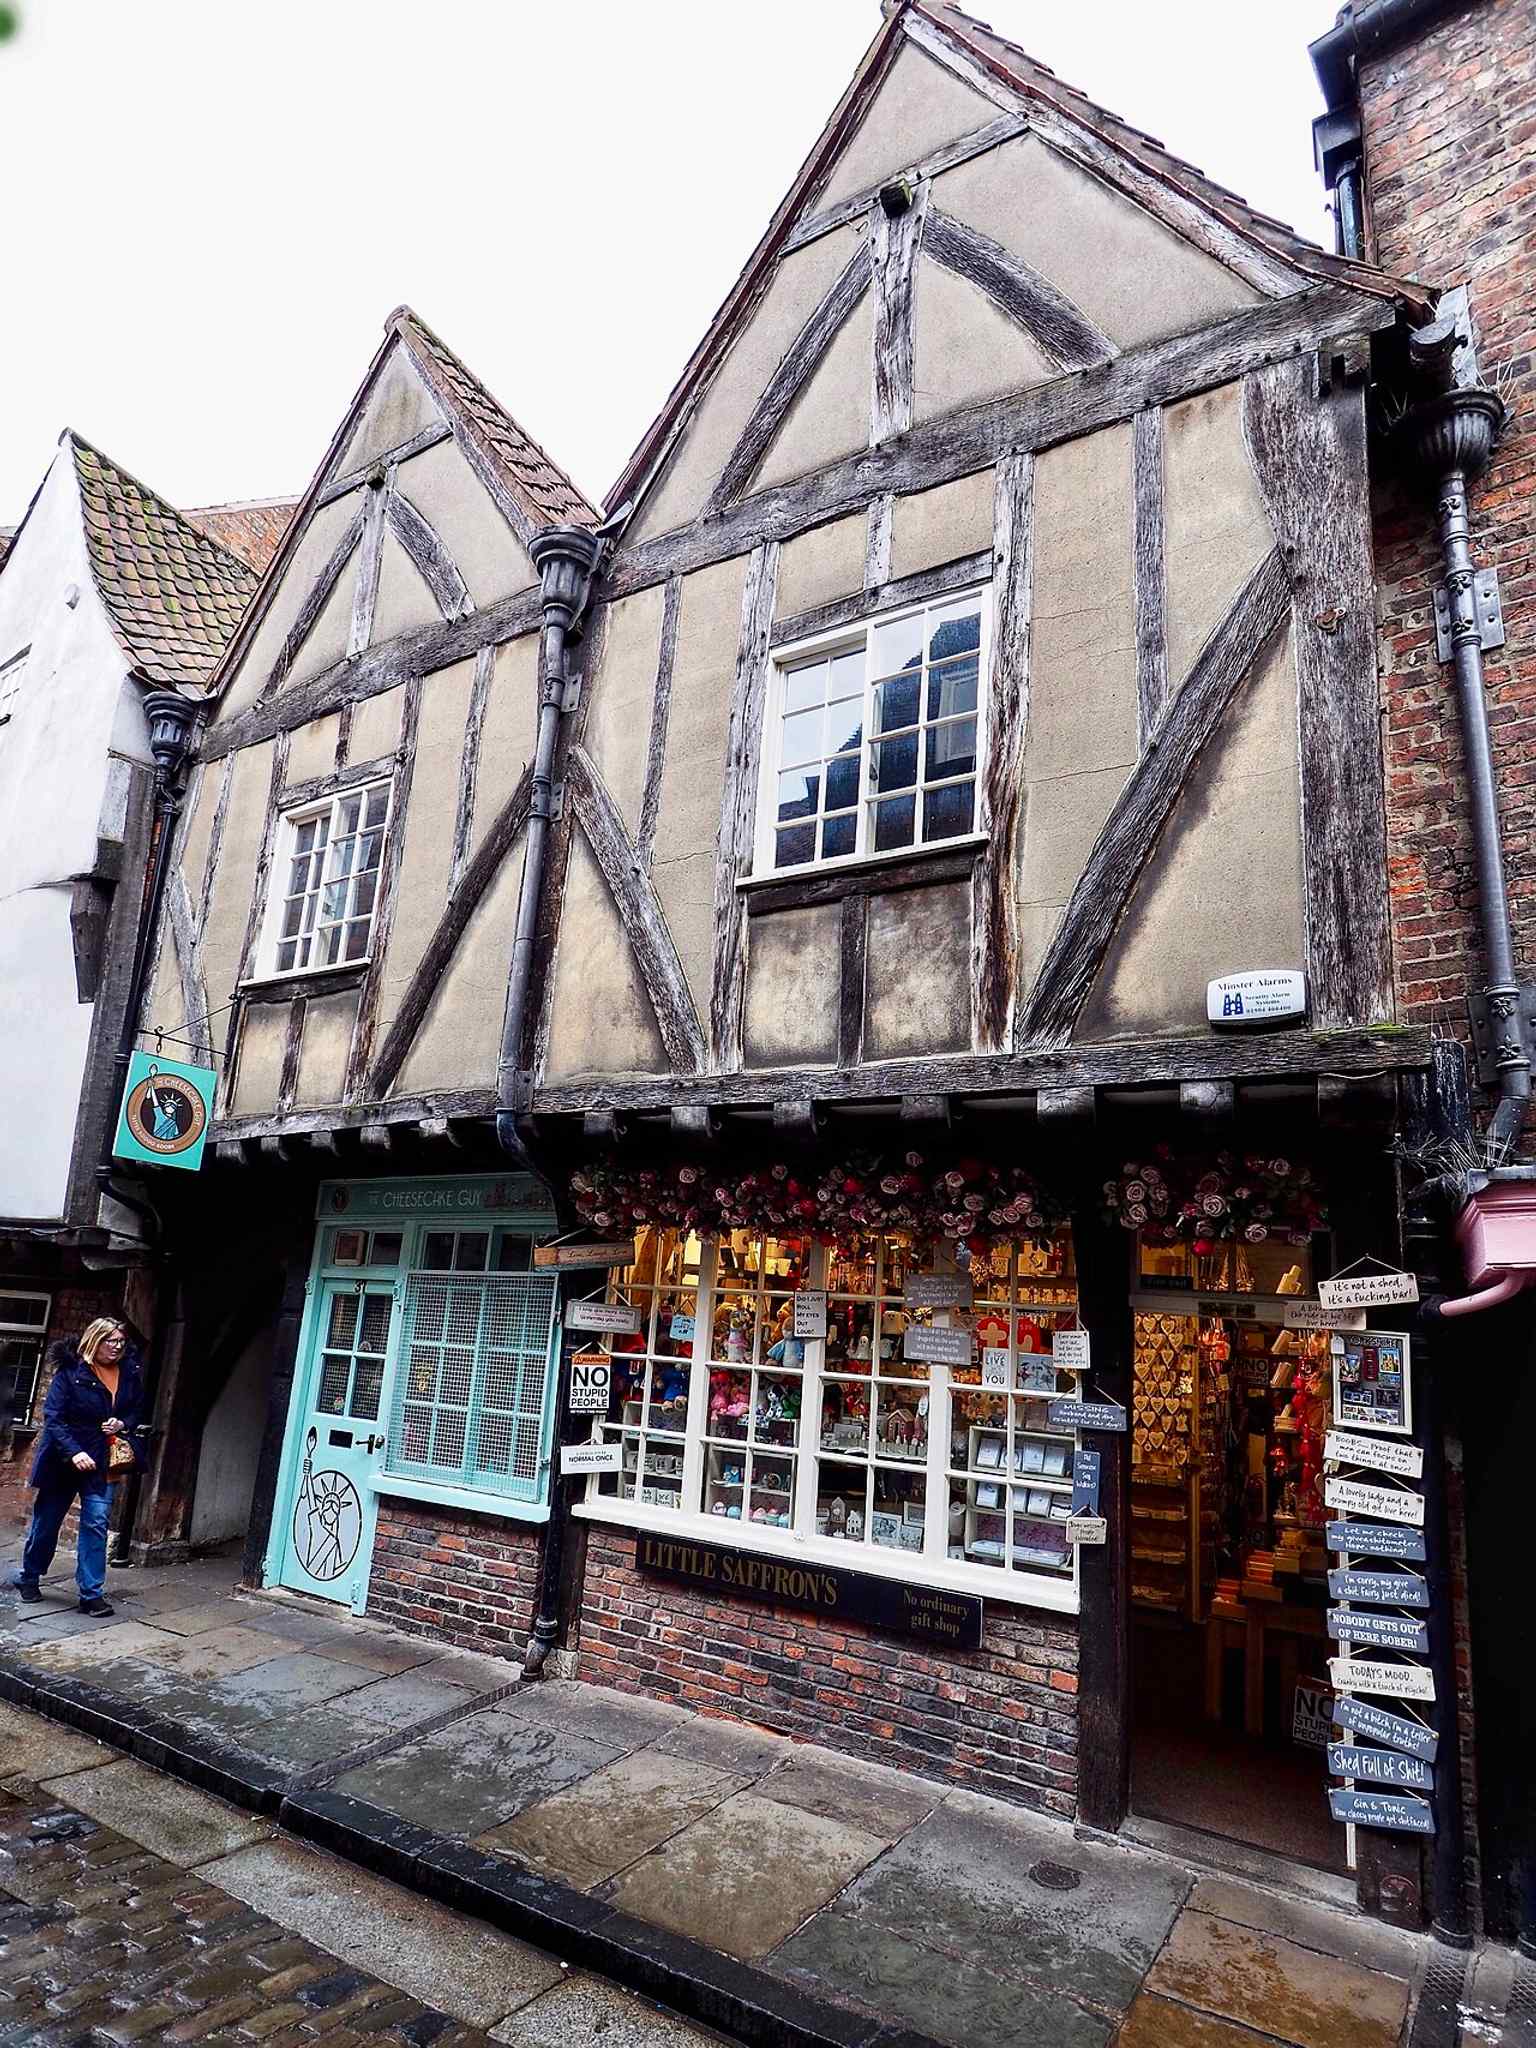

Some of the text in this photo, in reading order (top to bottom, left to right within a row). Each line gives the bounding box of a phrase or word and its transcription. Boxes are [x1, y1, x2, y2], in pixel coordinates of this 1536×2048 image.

[1218, 978, 1292, 990] Minster Alarms
[383, 1190, 453, 1208] CHEESECAKE
[457, 1188, 481, 1206] GUY
[1334, 1281, 1349, 1291] It's
[1352, 1280, 1366, 1290] not
[1328, 1294, 1343, 1305] It's
[1355, 1290, 1390, 1302] fucking
[1392, 1288, 1412, 1299] bar!
[573, 1367, 609, 1387] NO
[986, 1375, 1005, 1385] YOU
[572, 1389, 608, 1397] STUPID
[571, 1398, 607, 1407] PEOPLE
[569, 1455, 594, 1463] NORMAL
[1373, 1450, 1395, 1460] focus
[1339, 1485, 1344, 1495] A
[1346, 1487, 1366, 1500] lovely
[1367, 1490, 1385, 1504] lady
[1387, 1496, 1402, 1506] and
[1330, 1496, 1356, 1509] grumpy
[1358, 1500, 1370, 1511] old
[1384, 1505, 1397, 1514] live
[1399, 1508, 1418, 1518] here!
[1344, 1527, 1360, 1535] Let
[1377, 1530, 1404, 1538] check
[1370, 1545, 1407, 1555] nothing!
[644, 1539, 838, 1606] LITTLE SAFFRON'S
[1344, 1574, 1355, 1584] I'm
[1380, 1580, 1392, 1589] my
[1393, 1579, 1408, 1590] give
[1344, 1586, 1359, 1596] shit
[1381, 1589, 1398, 1600] just
[1401, 1591, 1421, 1602] died!
[904, 1588, 968, 1617] No ordinary
[911, 1611, 960, 1638] gift shop
[1332, 1613, 1420, 1635] NOBODY GETS OUT
[1338, 1628, 1417, 1648] OF HERE SOBER!
[1337, 1678, 1357, 1688] Cranky
[1359, 1680, 1370, 1688] with
[1378, 1681, 1395, 1690] touch
[1396, 1683, 1402, 1693] of
[1340, 1701, 1350, 1713] I'm
[1351, 1707, 1363, 1718] not
[1364, 1712, 1369, 1720] a
[1392, 1721, 1402, 1732] I'm
[1403, 1727, 1409, 1735] a
[1411, 1728, 1431, 1743] teller
[1348, 1717, 1357, 1726] of
[1334, 1749, 1360, 1776] Shed
[1383, 1756, 1395, 1778] of
[1398, 1759, 1425, 1782] Shit!
[1353, 1799, 1406, 1814] Gin & Tonic
[1348, 1809, 1367, 1822] classy
[1368, 1813, 1385, 1823] people
[1386, 1815, 1397, 1825] get
[1398, 1816, 1430, 1830] shitfaced!
